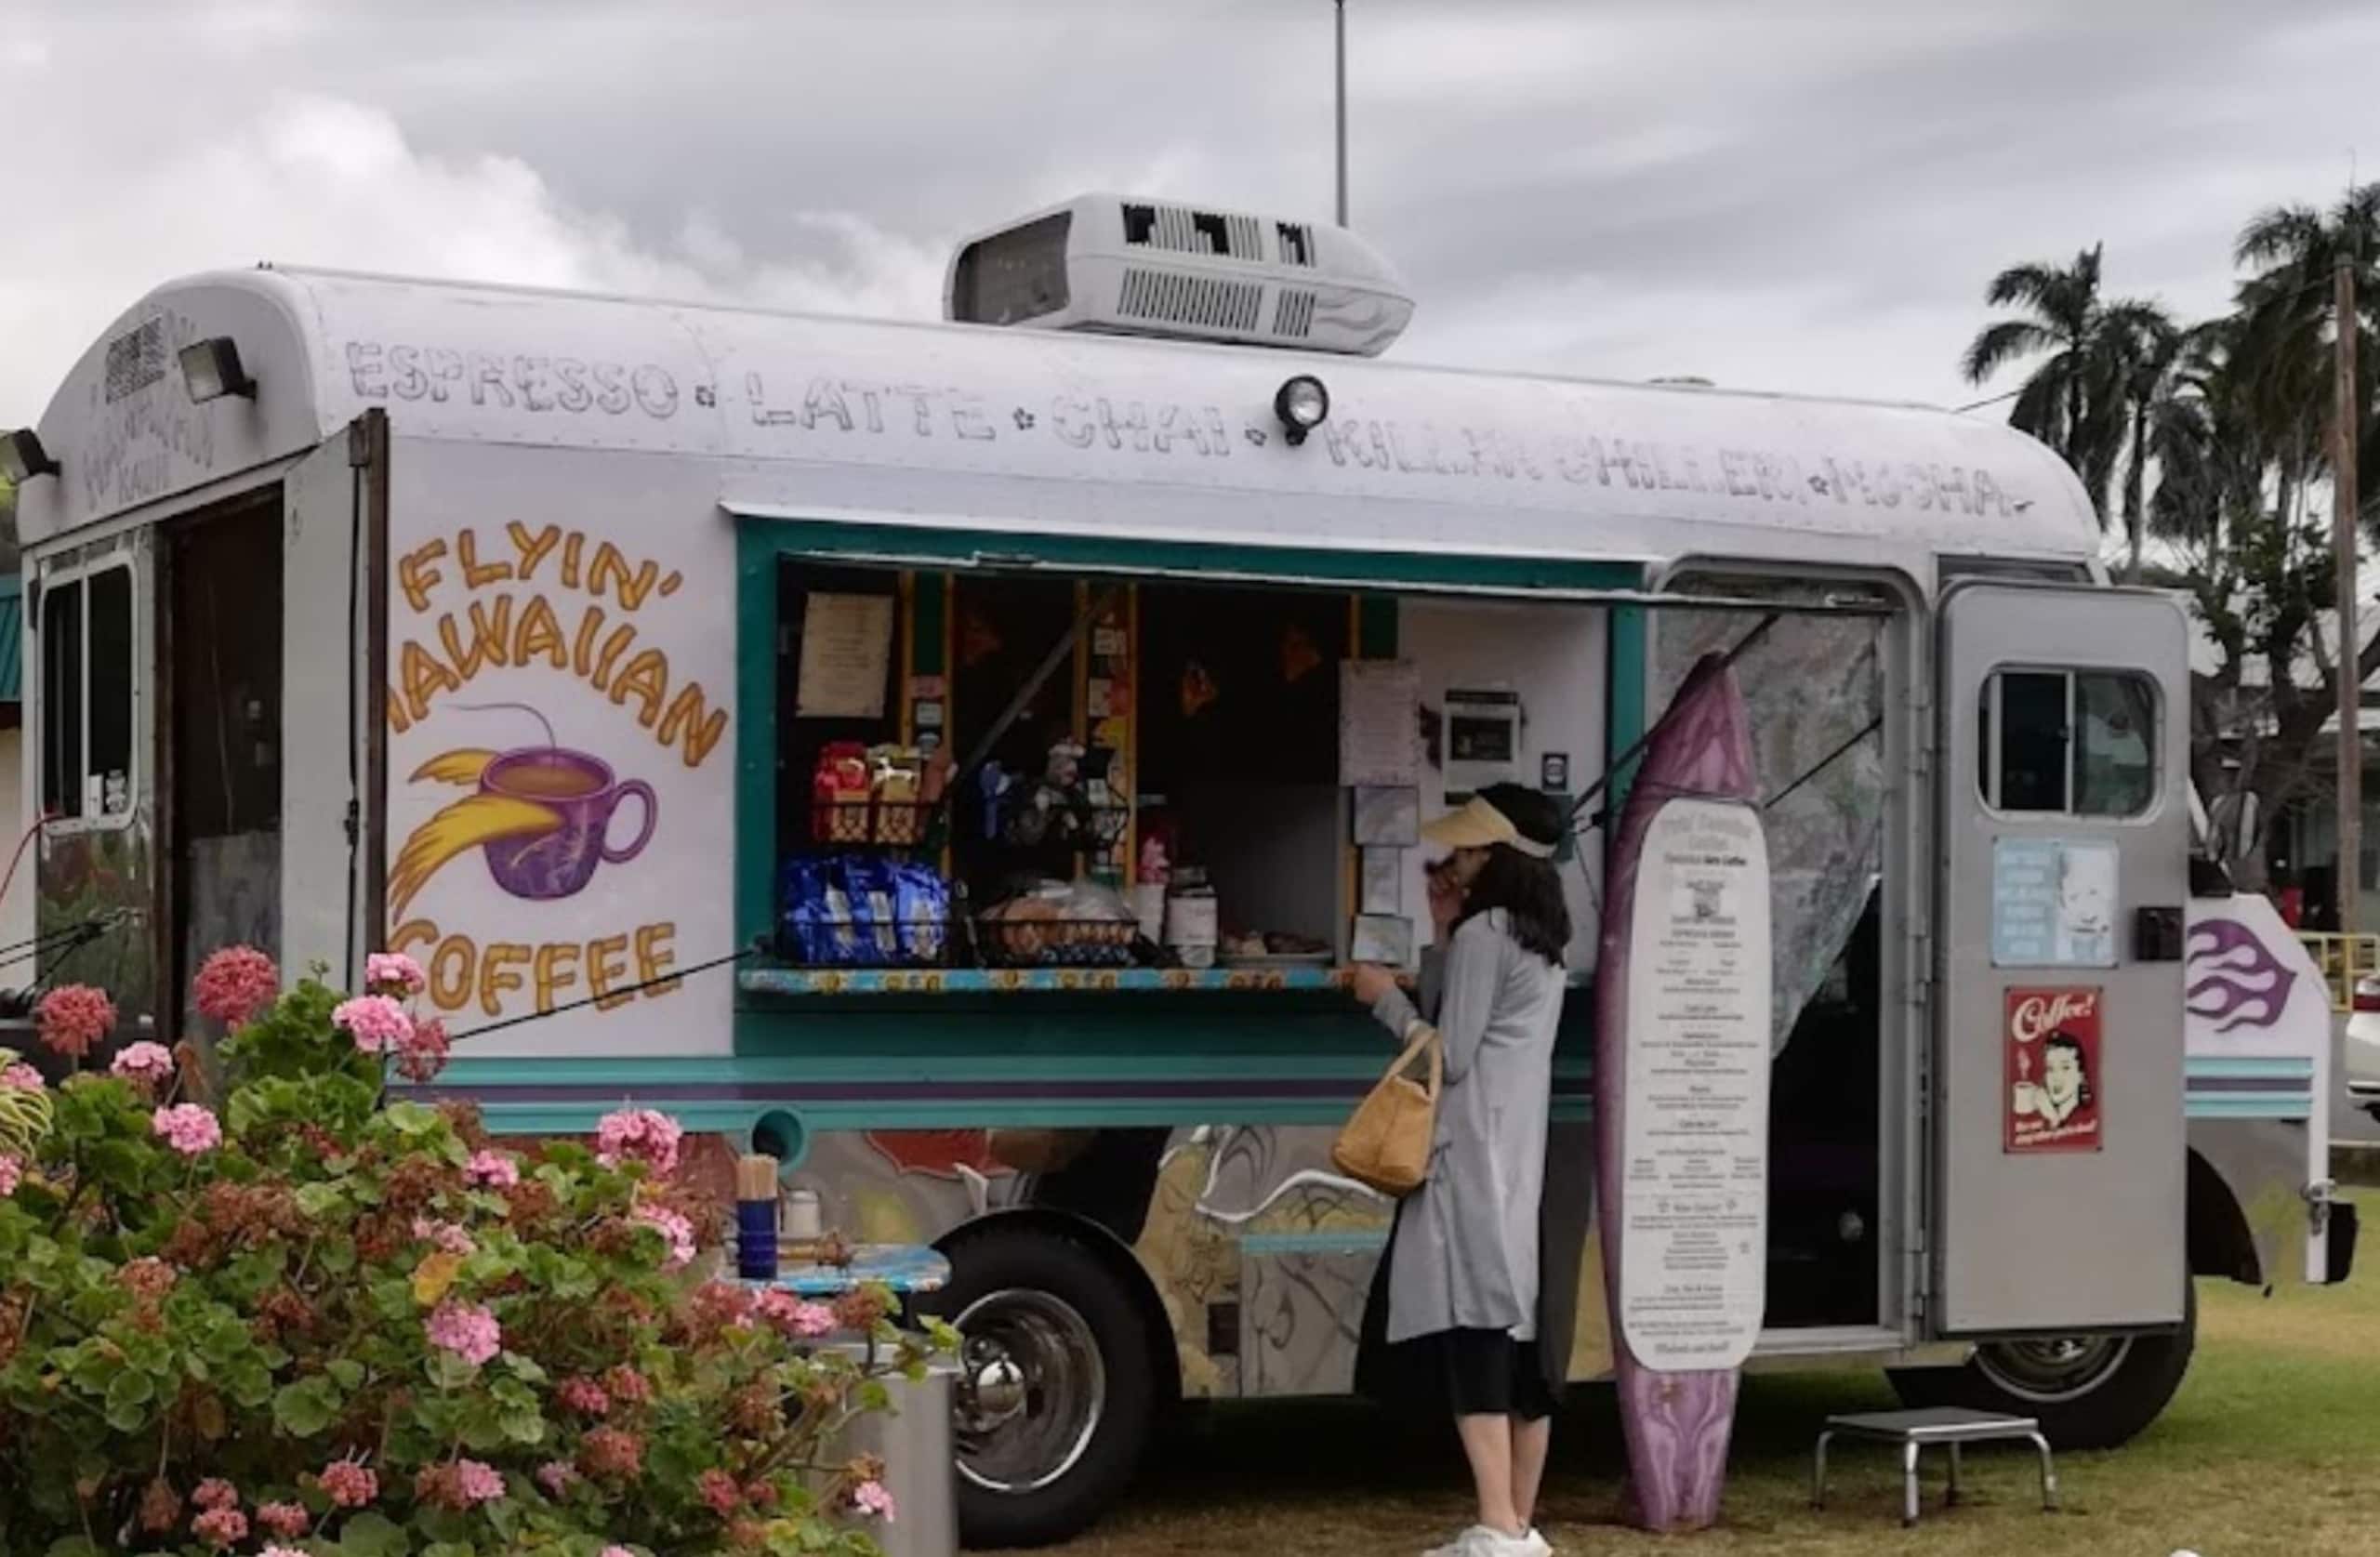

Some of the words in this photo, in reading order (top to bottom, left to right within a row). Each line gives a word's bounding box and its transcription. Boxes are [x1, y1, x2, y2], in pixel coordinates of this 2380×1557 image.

[346, 341, 679, 419] ESPRESSO
[747, 373, 996, 441] LATTE
[1051, 393, 1232, 456] CHAI
[398, 520, 683, 613] FLYIN'
[2012, 993, 2096, 1043] Coffee!
